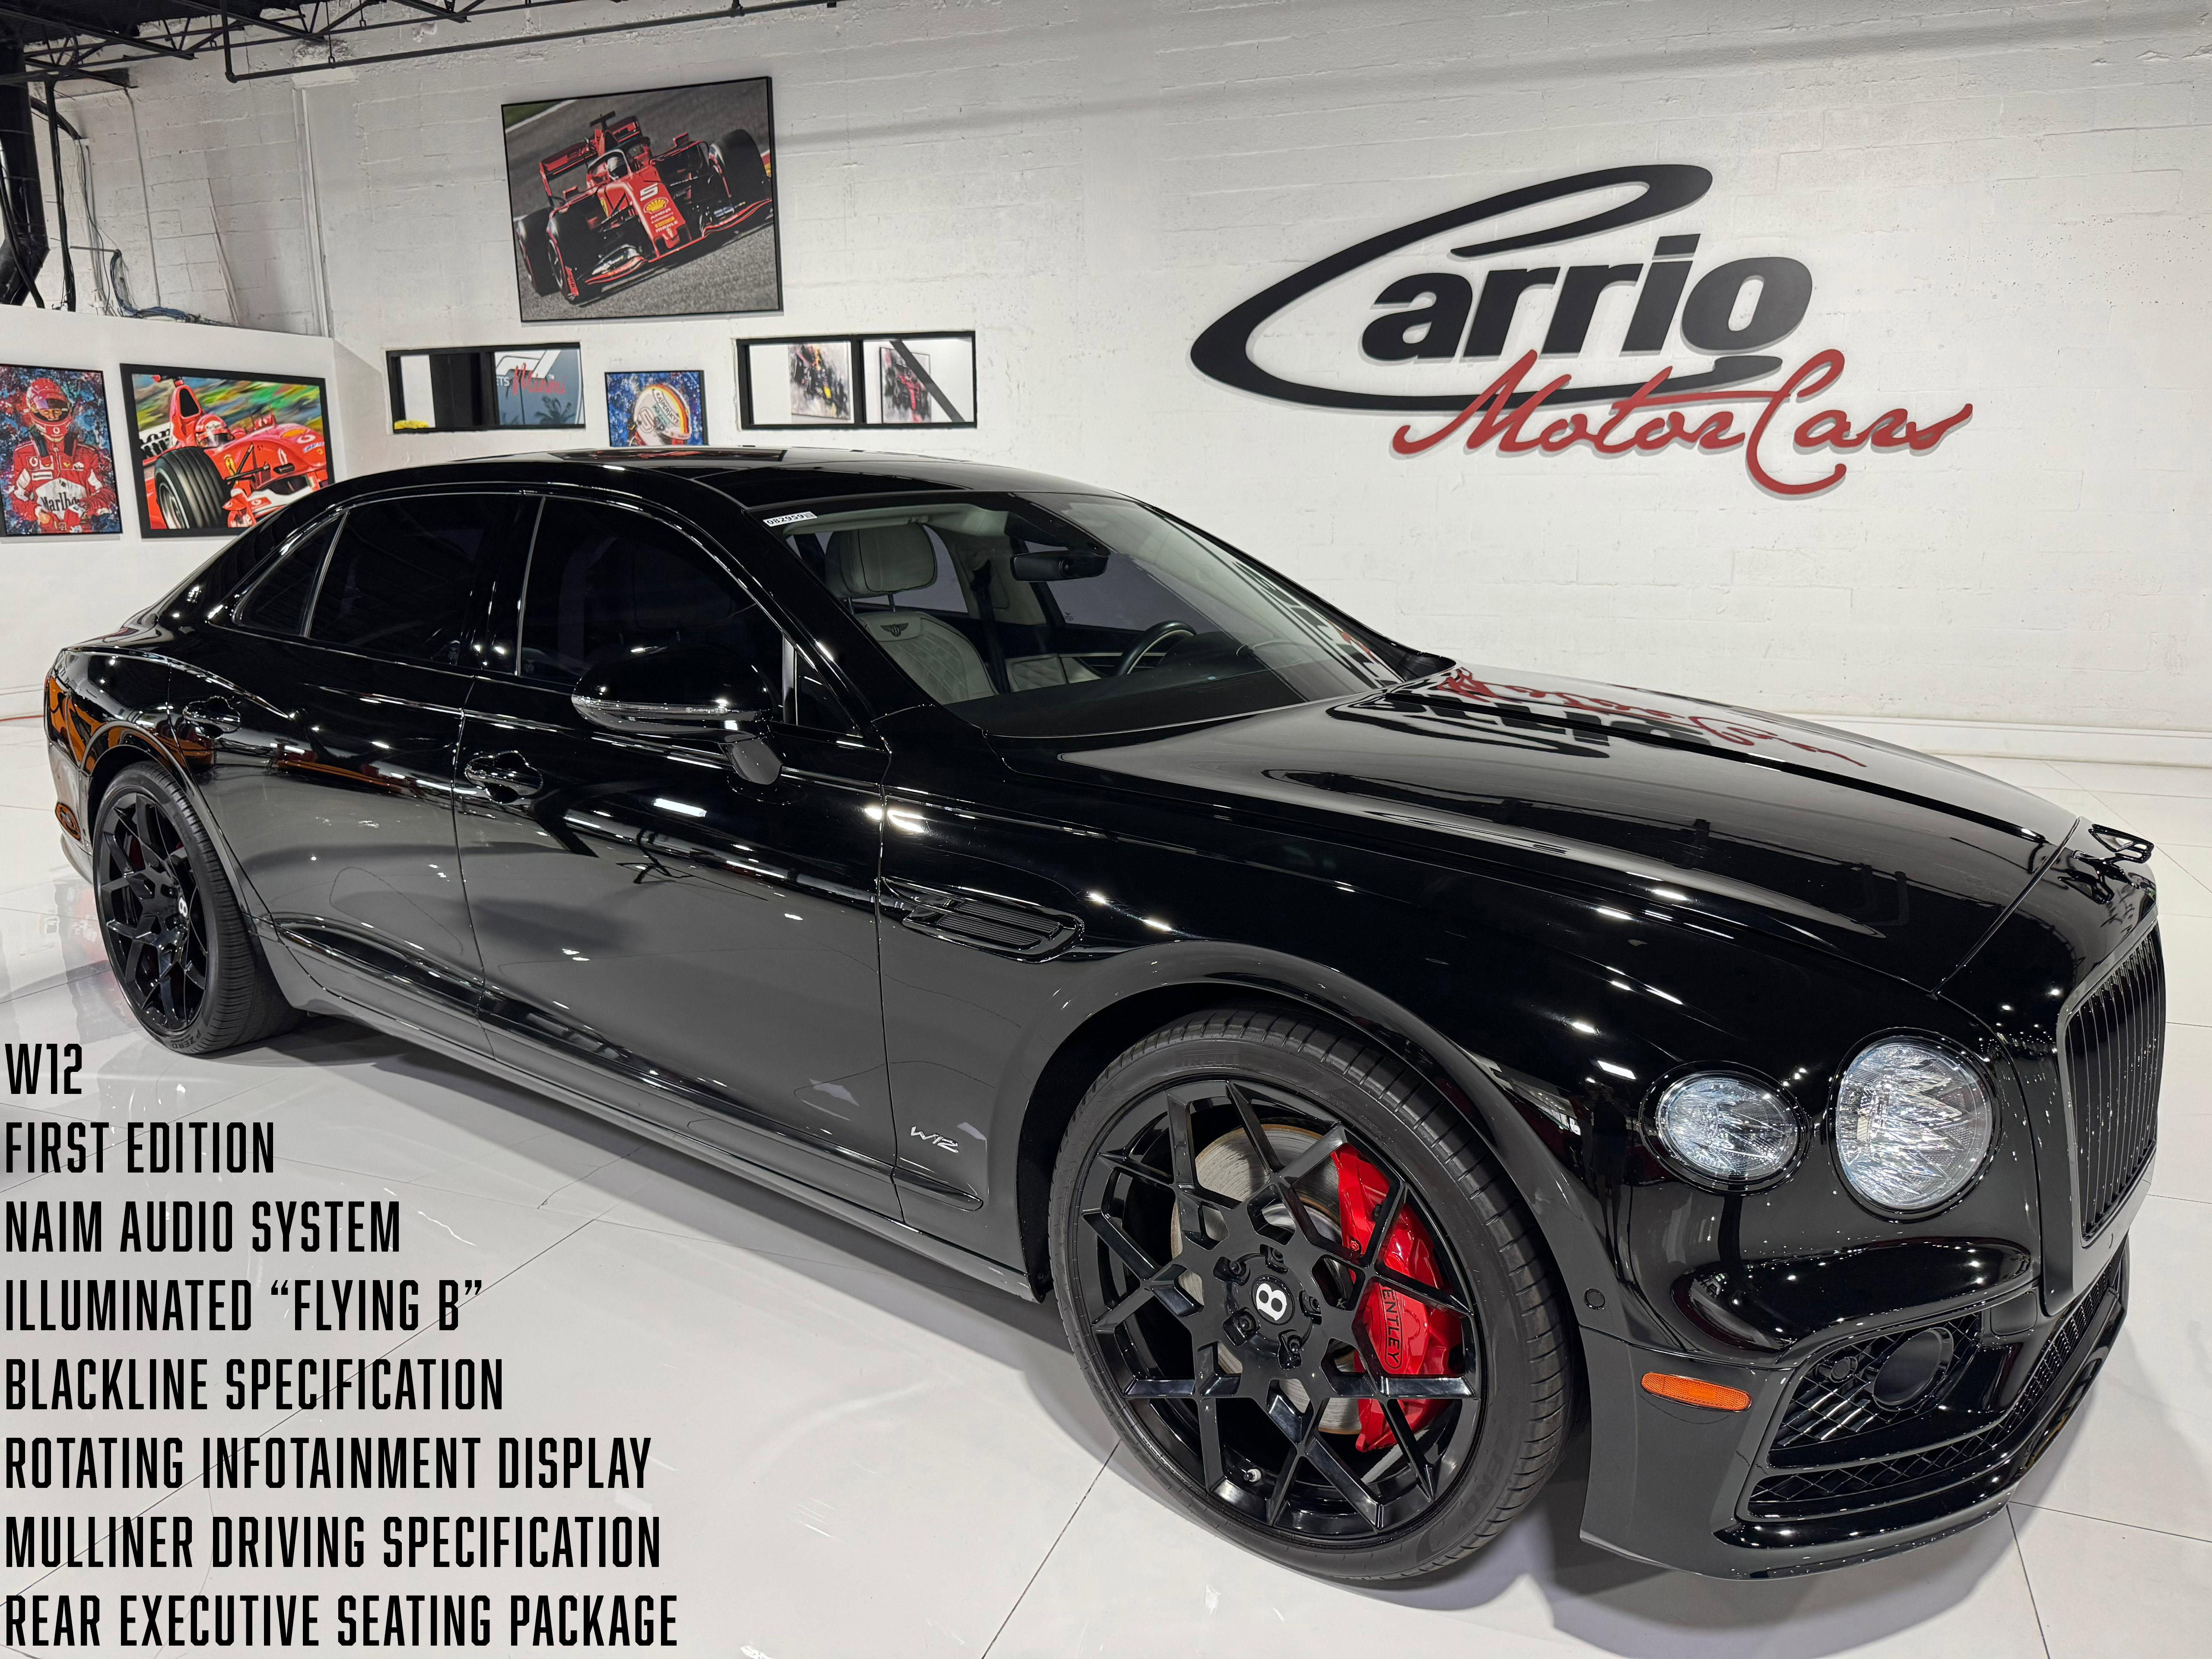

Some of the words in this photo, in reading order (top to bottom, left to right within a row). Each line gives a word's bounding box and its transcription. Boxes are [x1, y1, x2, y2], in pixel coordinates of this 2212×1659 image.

[1191, 165, 1813, 412] Carrio
[767, 514, 804, 524] 082959
[1256, 1283, 1287, 1321] B
[1382, 1289, 1400, 1363] ENTLEY
